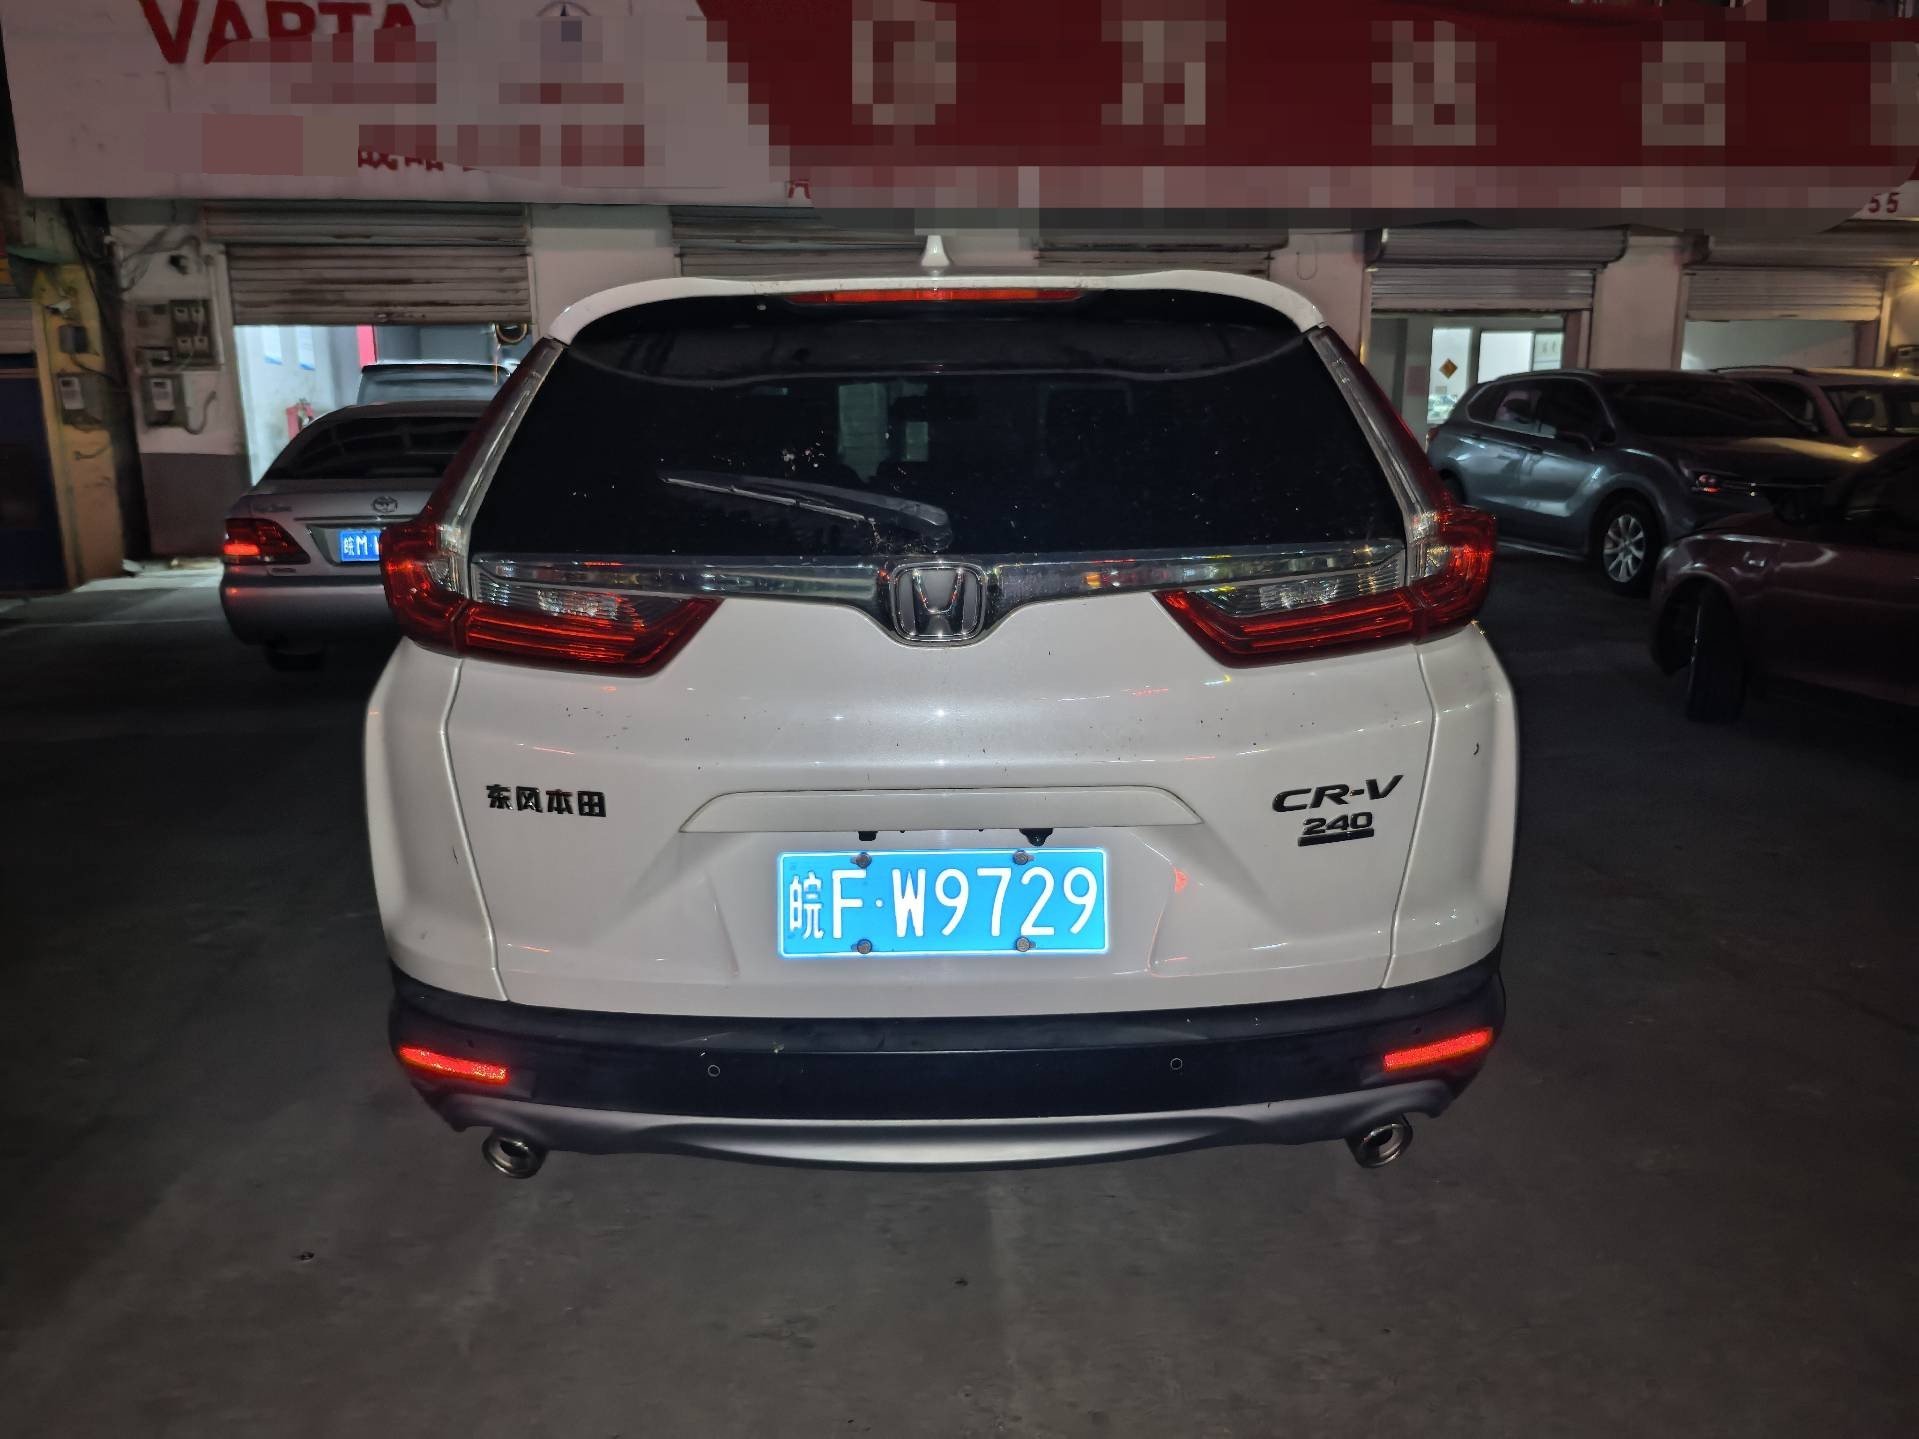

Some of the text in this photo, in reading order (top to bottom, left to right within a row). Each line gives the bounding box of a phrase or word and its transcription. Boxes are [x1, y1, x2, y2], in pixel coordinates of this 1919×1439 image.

[485, 783, 607, 818] 东风本田
[1272, 774, 1404, 813] CR-V
[1302, 811, 1373, 836] 240
